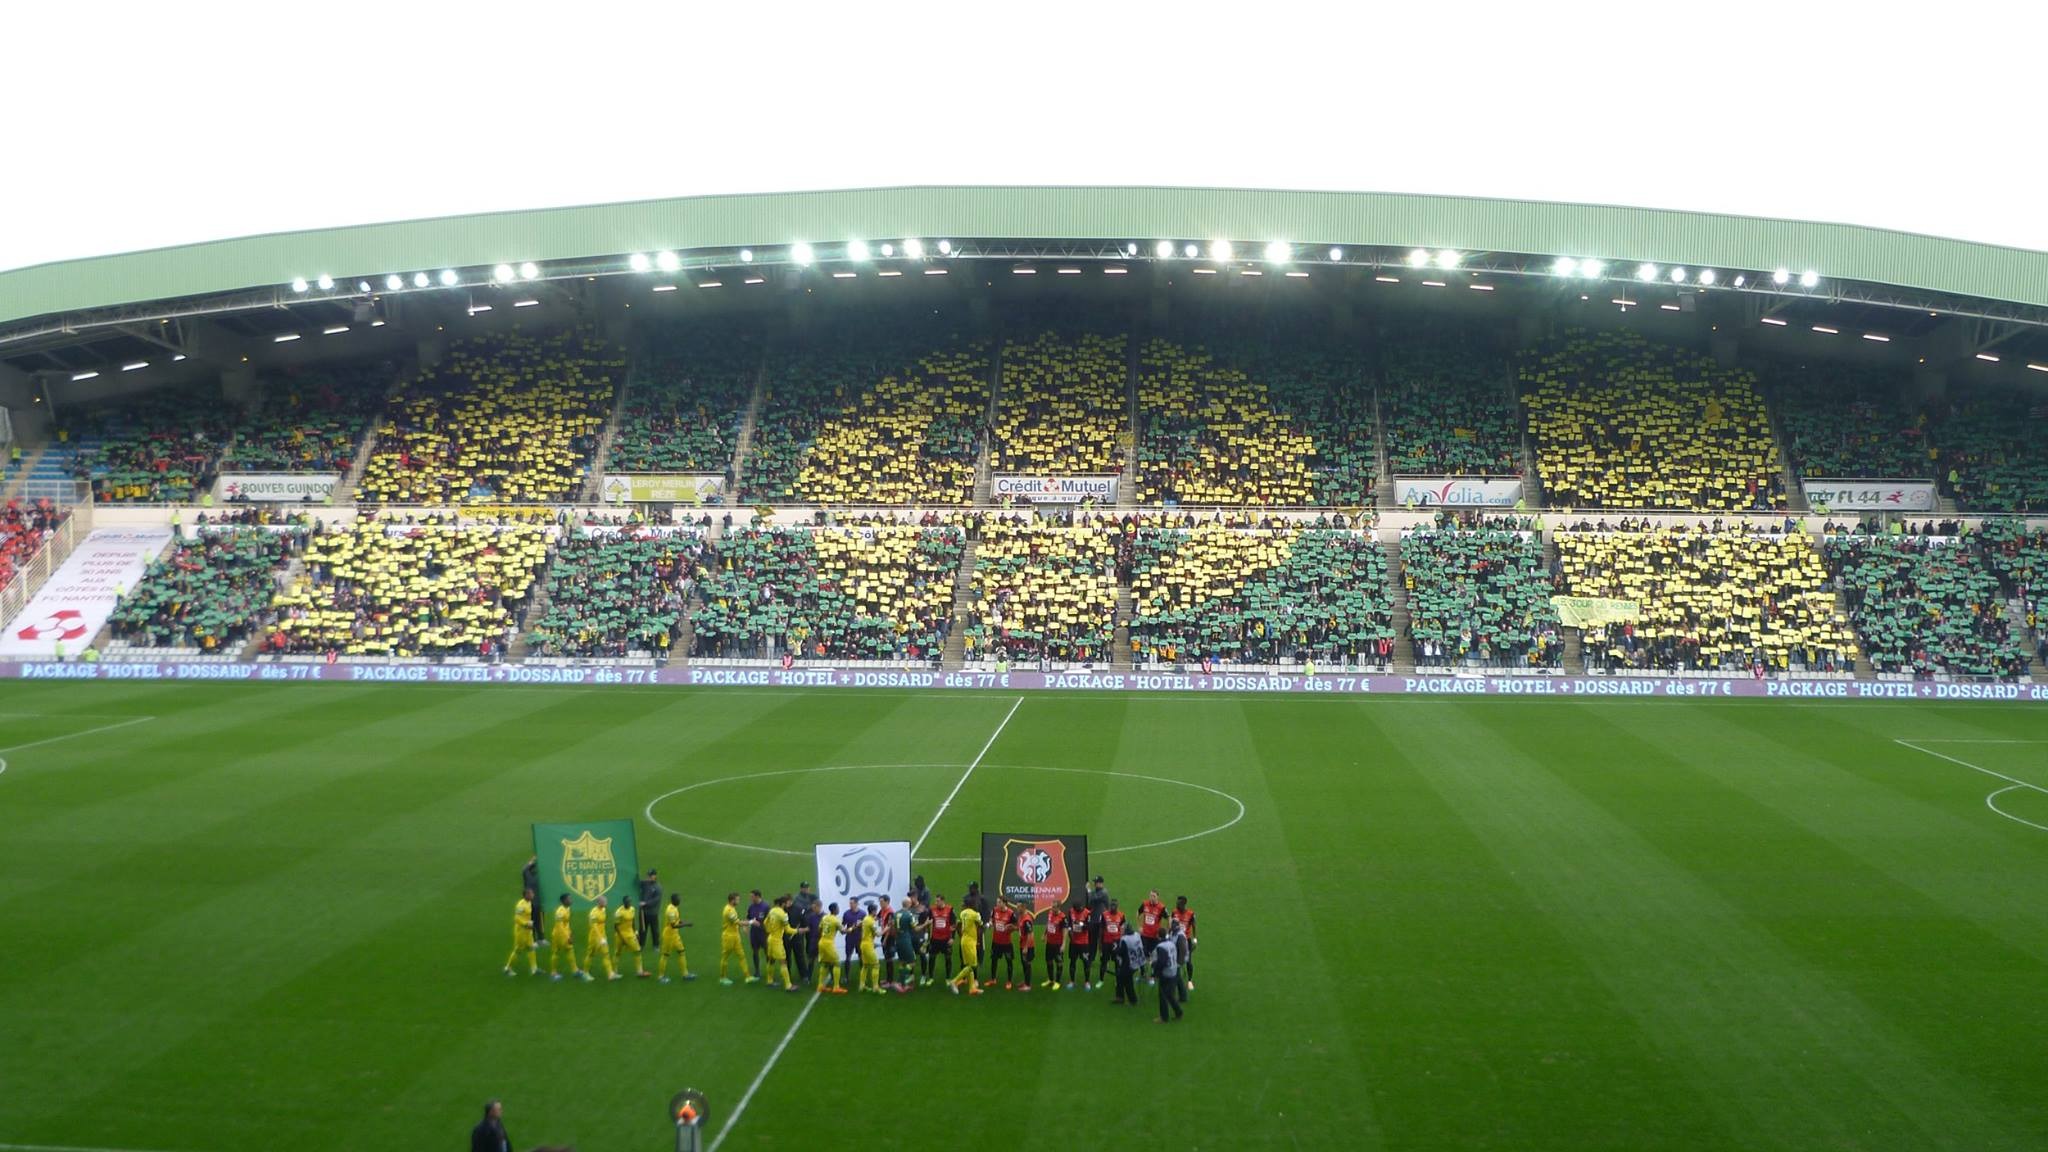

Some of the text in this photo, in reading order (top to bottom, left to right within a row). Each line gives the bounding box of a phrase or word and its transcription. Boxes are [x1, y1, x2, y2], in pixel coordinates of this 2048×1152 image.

[242, 483, 285, 494] BOUYER
[998, 479, 1111, 492] Crédit Mutuel
[1857, 490, 1881, 504] 44
[23, 664, 98, 677] PACKAGE
[102, 664, 161, 677] "HOTEL
[179, 664, 258, 678] DOSSARD"
[261, 665, 288, 678] dès
[292, 666, 309, 678] 77
[312, 666, 320, 678] €
[353, 667, 428, 680] PACKAGE
[433, 668, 492, 681] "HOTEL
[509, 669, 590, 682] DOSSARD"
[596, 669, 622, 682] dès
[627, 670, 645, 682] 77
[650, 670, 658, 683] €
[692, 671, 768, 684] PACKAGE
[774, 672, 836, 685] "HOTEL
[855, 673, 940, 686] DOSSARD"
[945, 673, 972, 686] dès
[977, 674, 996, 687] 77
[1000, 674, 1008, 687] €
[1045, 675, 1124, 688] PACKAGE
[1130, 676, 1193, 689] "HOTEL
[1212, 677, 1299, 690] DOSSARD"
[1304, 677, 1332, 691] dès
[1337, 678, 1356, 691] 77
[1360, 678, 1370, 691] €
[1405, 679, 1486, 692] PACKAGE
[1491, 680, 1556, 693] "HOTEL
[1574, 680, 1661, 694] DOSSARD"
[1666, 681, 1694, 694] dès
[1699, 681, 1718, 694] 77
[1722, 681, 1732, 694] €
[1767, 682, 1847, 696] PACKAGE
[1852, 683, 1916, 696] "HOTEL
[1936, 684, 2026, 698] DOSSARD"
[567, 862, 612, 870] FC NANTES
[1006, 886, 1062, 894] STADE RENNAIS
